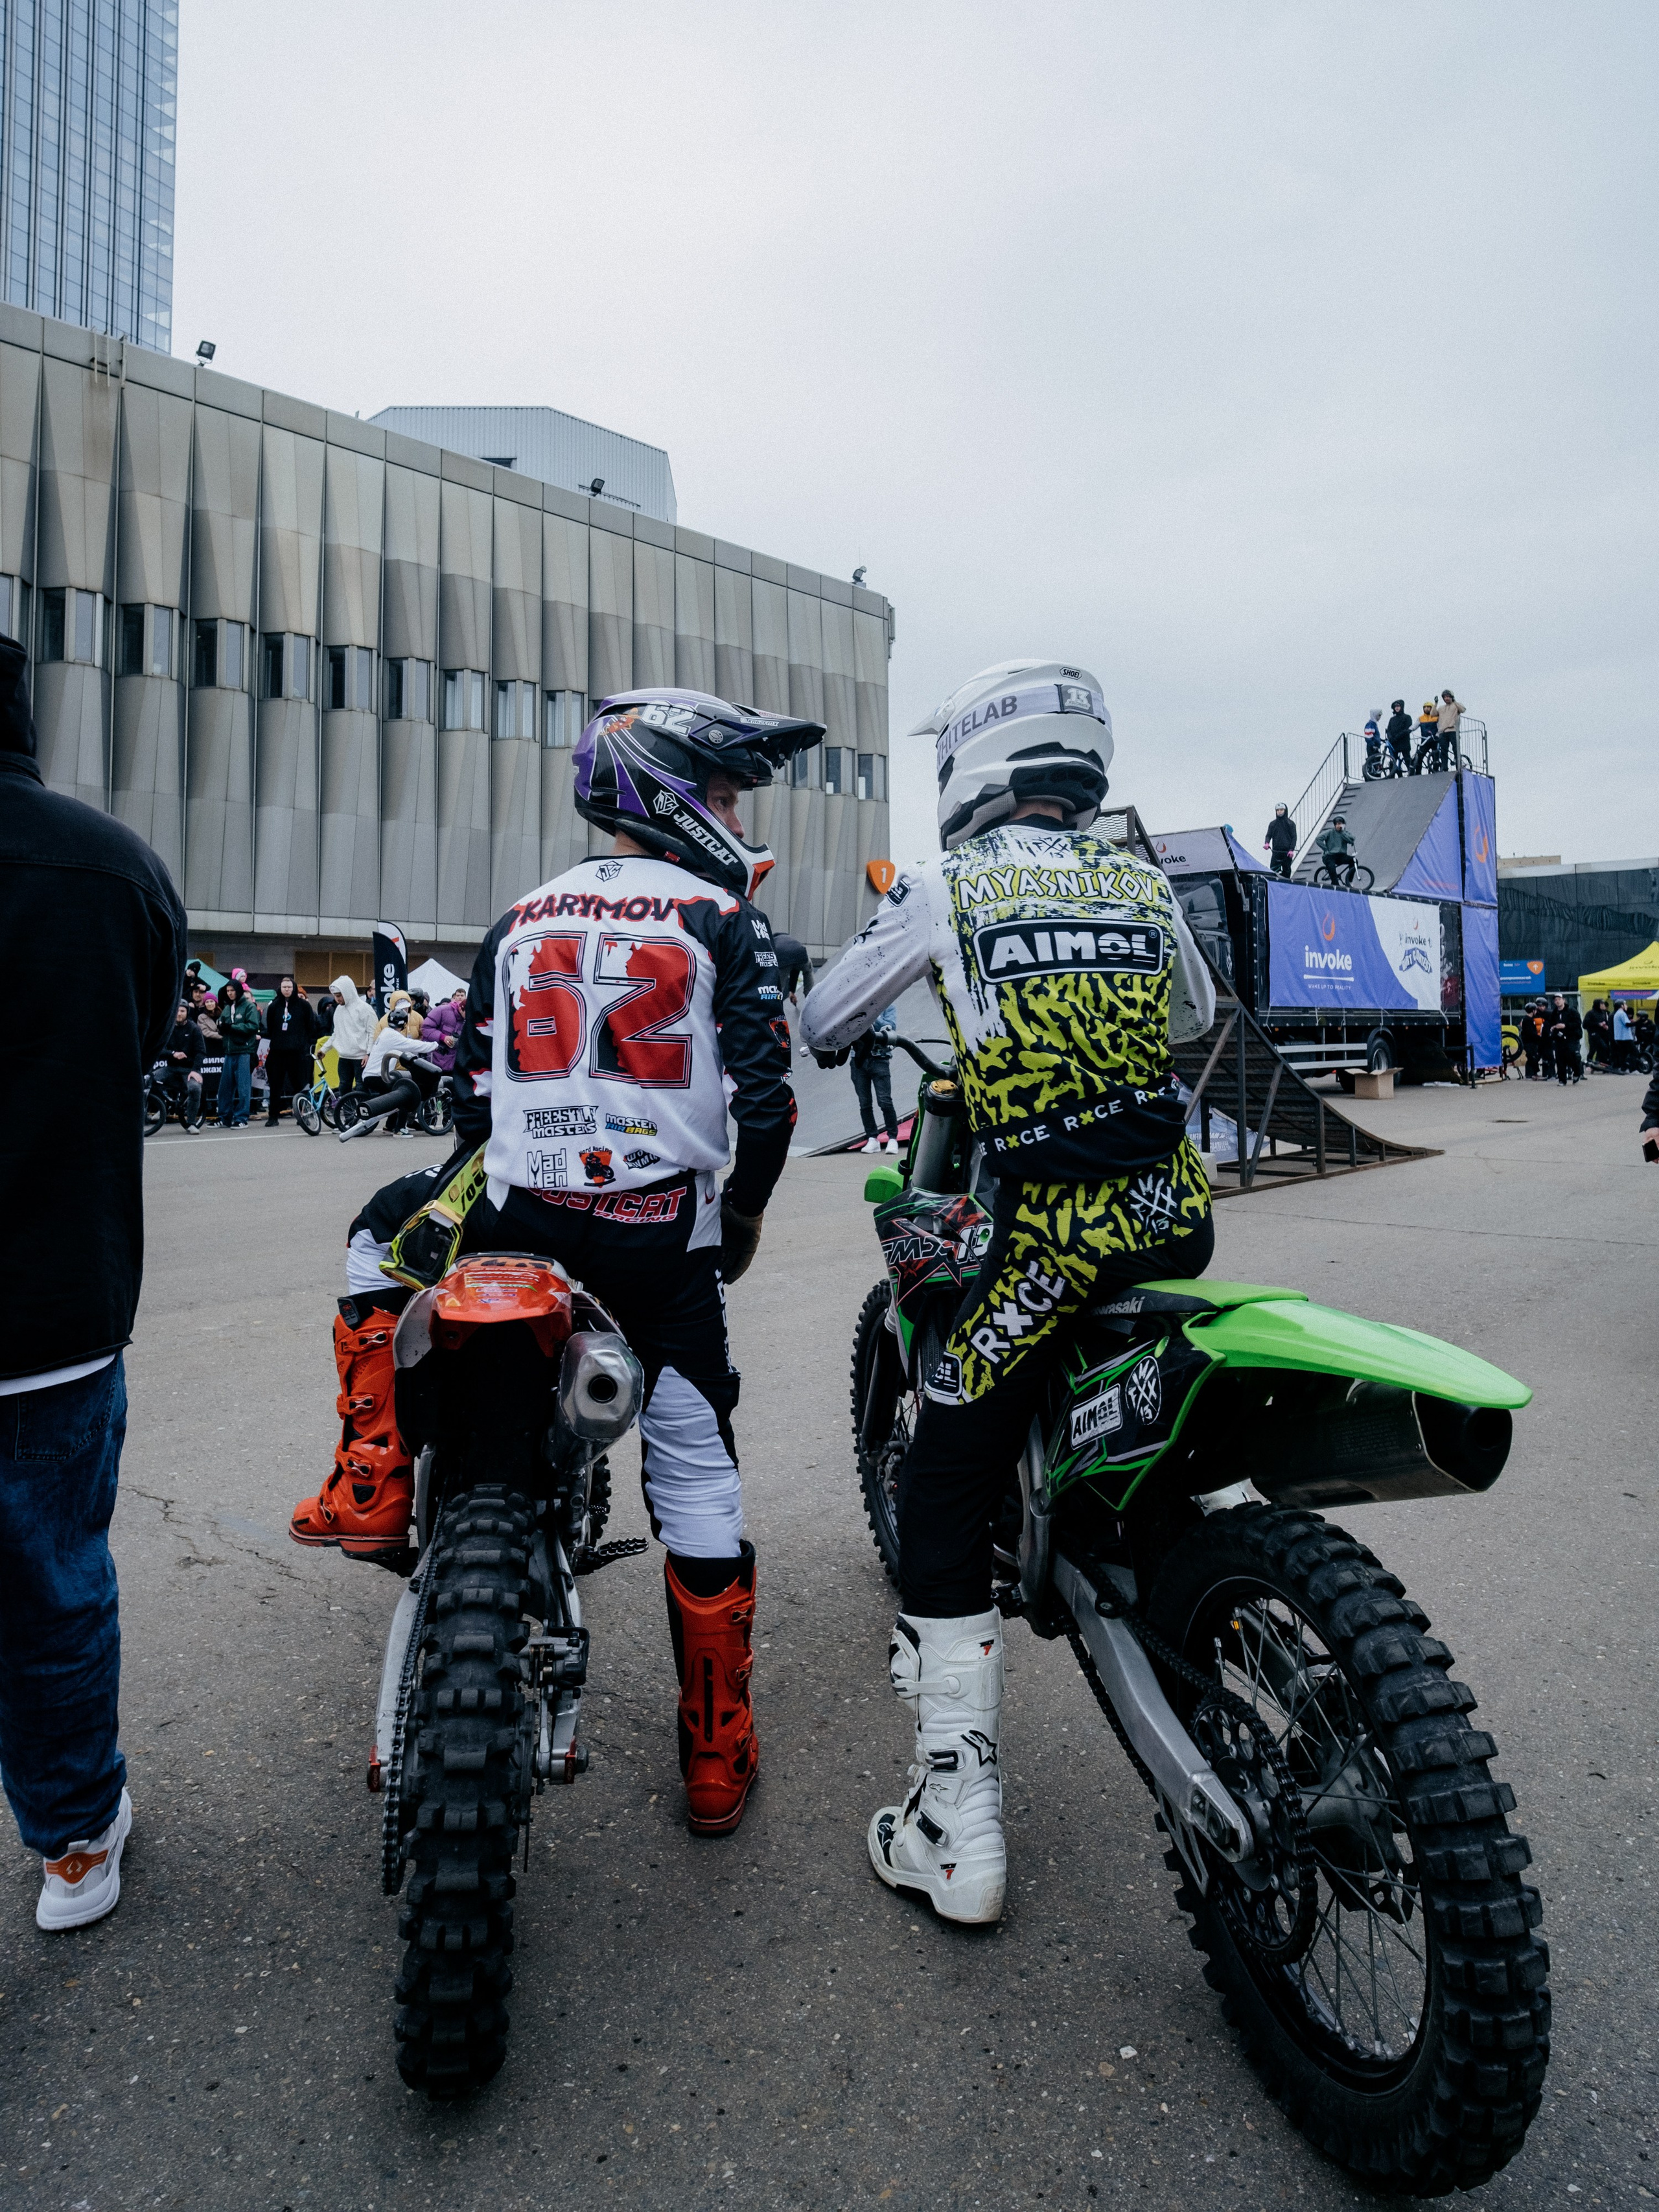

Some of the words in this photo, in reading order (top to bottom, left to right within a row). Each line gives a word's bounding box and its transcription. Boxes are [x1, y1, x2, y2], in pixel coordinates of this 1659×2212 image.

[1062, 668, 1080, 679] SHOEI
[642, 700, 697, 737] 62
[673, 810, 739, 865] JUSTCAT
[958, 868, 1153, 910] MYASNIKOV
[518, 892, 675, 927] KARYMOV
[1405, 933, 1426, 946] invoke
[1305, 945, 1352, 972] invoke
[502, 931, 697, 1089] 62
[528, 1148, 566, 1172] Mad
[592, 1146, 613, 1155] Racing
[528, 1170, 568, 1189] Men
[592, 1211, 678, 1224] RACING
